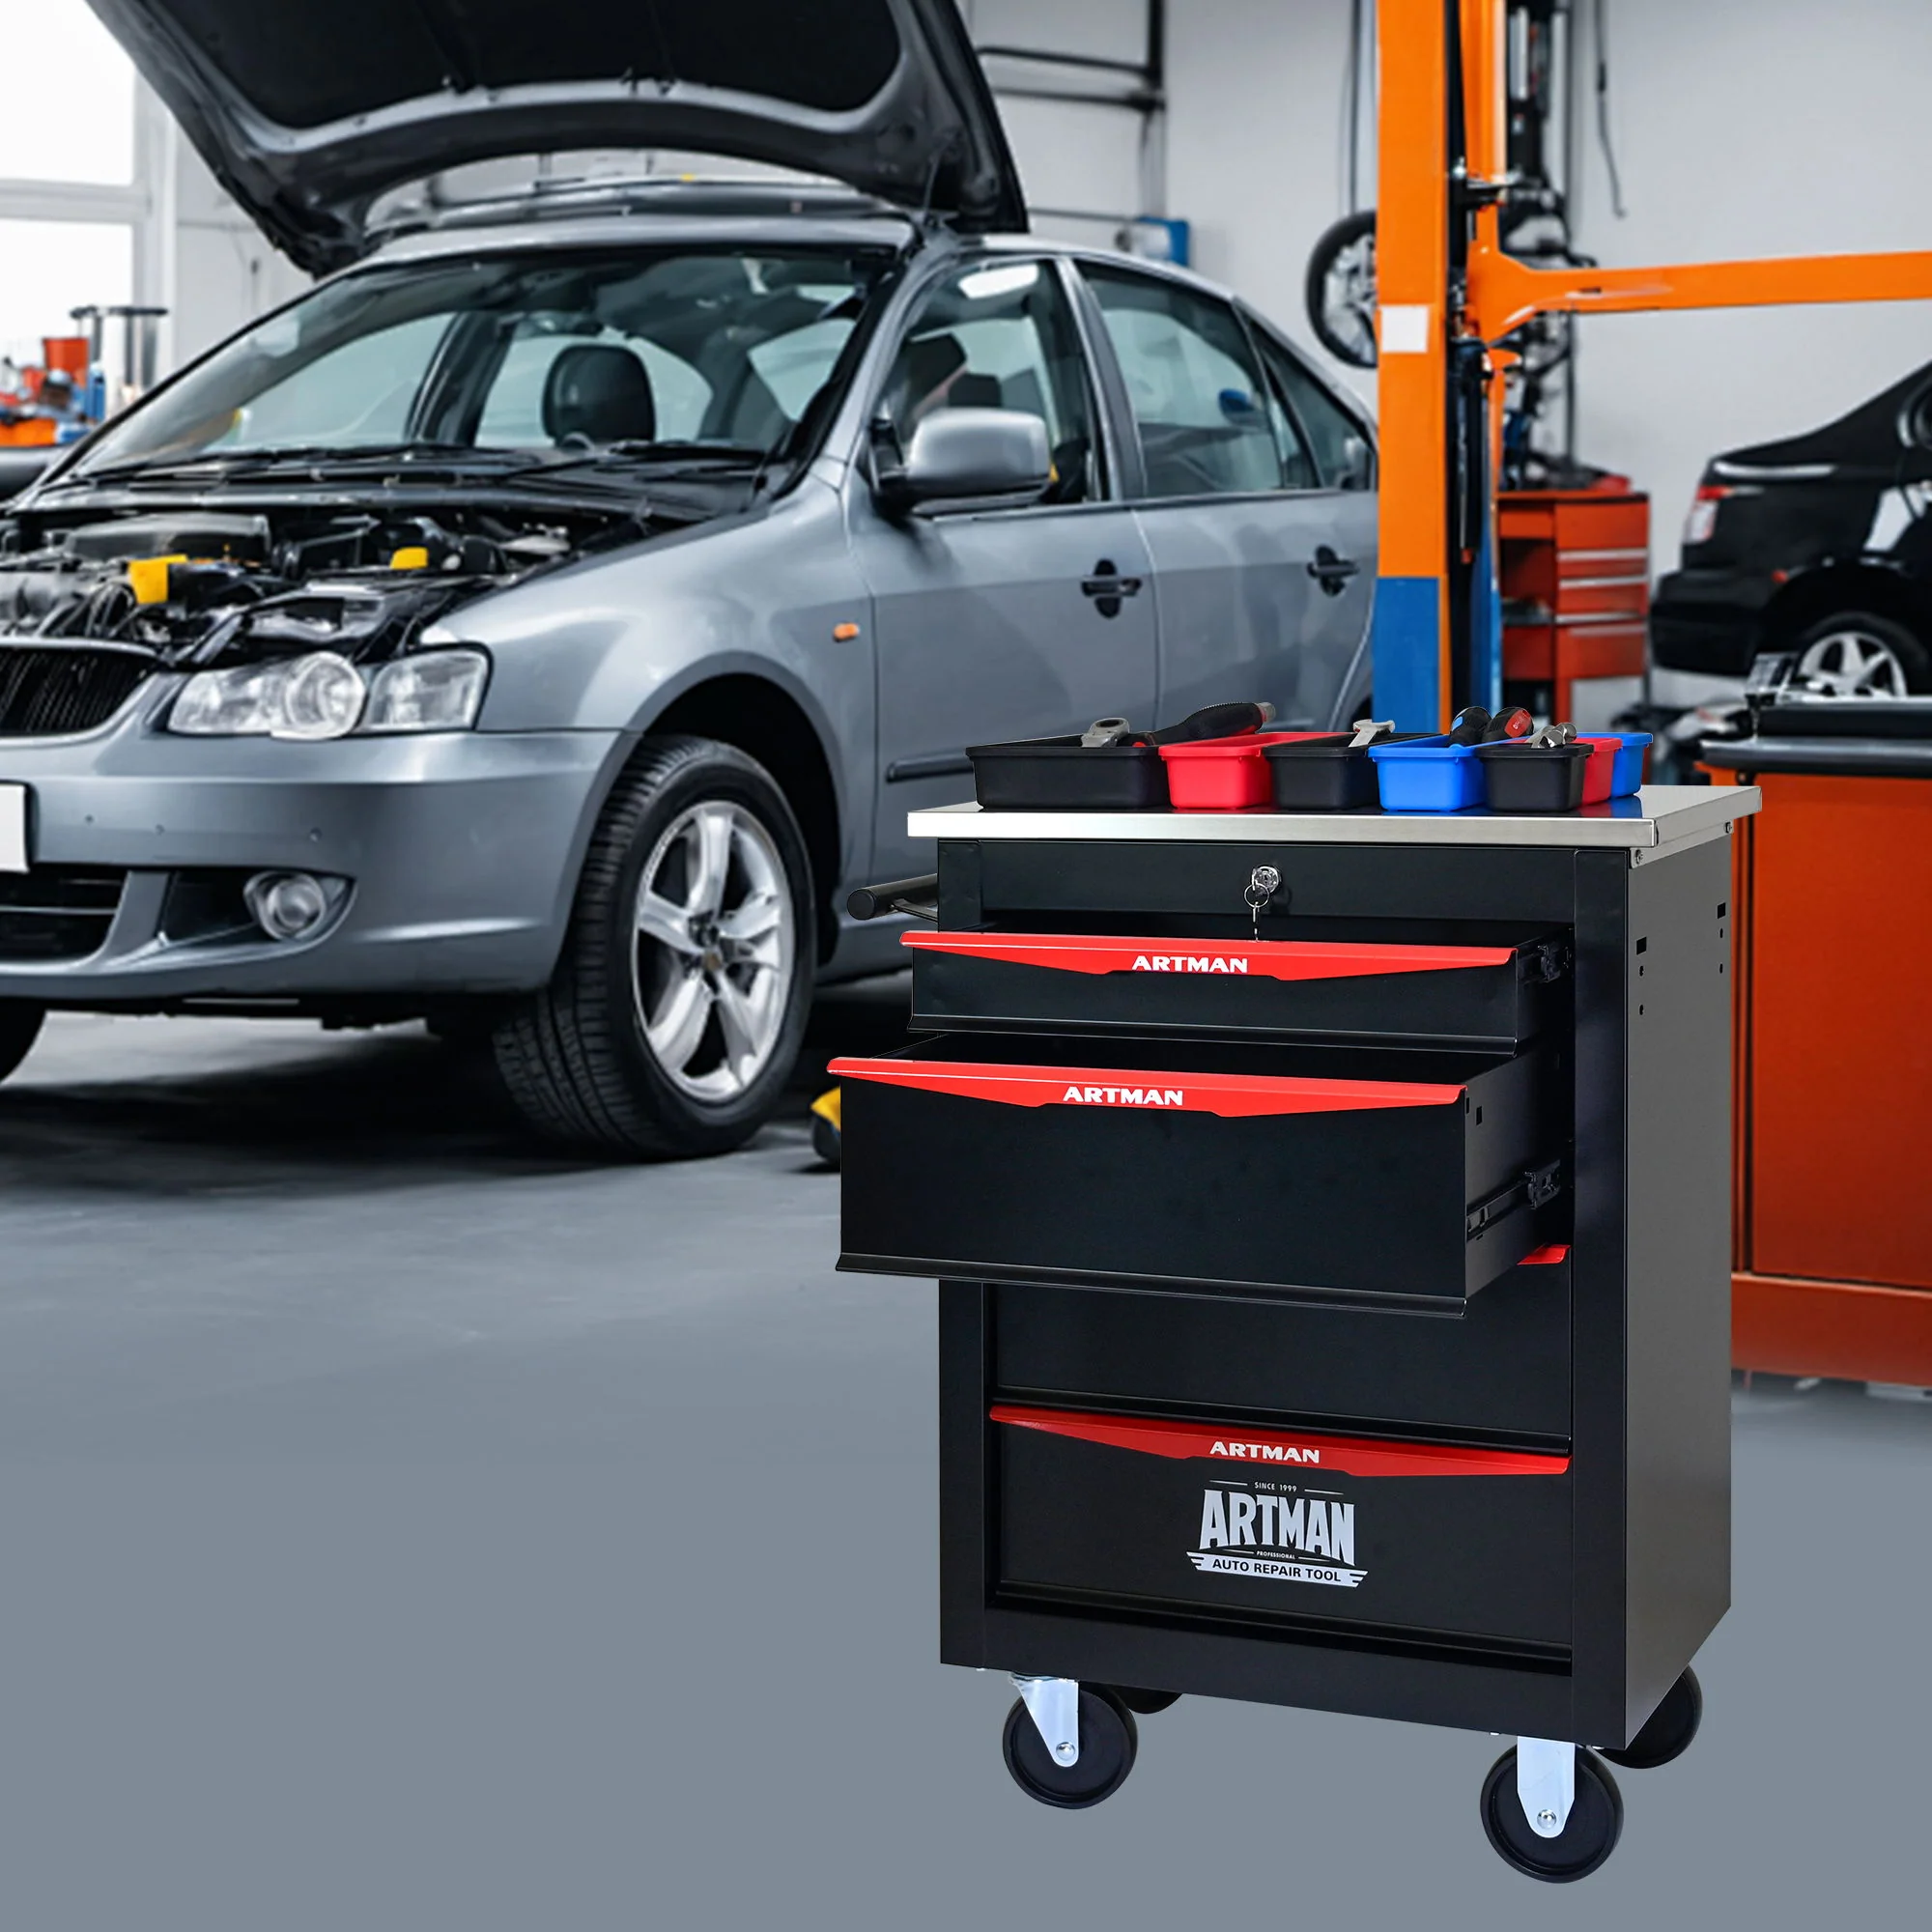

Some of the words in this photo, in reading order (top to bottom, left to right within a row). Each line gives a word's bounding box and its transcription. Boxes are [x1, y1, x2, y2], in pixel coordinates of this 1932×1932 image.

[1131, 955, 1248, 974] ARTMAN
[1063, 1086, 1183, 1106] ARTMAN
[1209, 1440, 1320, 1463] ARTMAN
[1254, 1481, 1276, 1491] SINCE
[1279, 1484, 1297, 1492] 1999
[1199, 1489, 1356, 1567] ARTMAN
[1256, 1550, 1296, 1560] PROFESSIONAL
[1212, 1558, 1249, 1572] AUTO
[1254, 1563, 1301, 1577] REPAIR
[1305, 1568, 1342, 1582] TOOL
